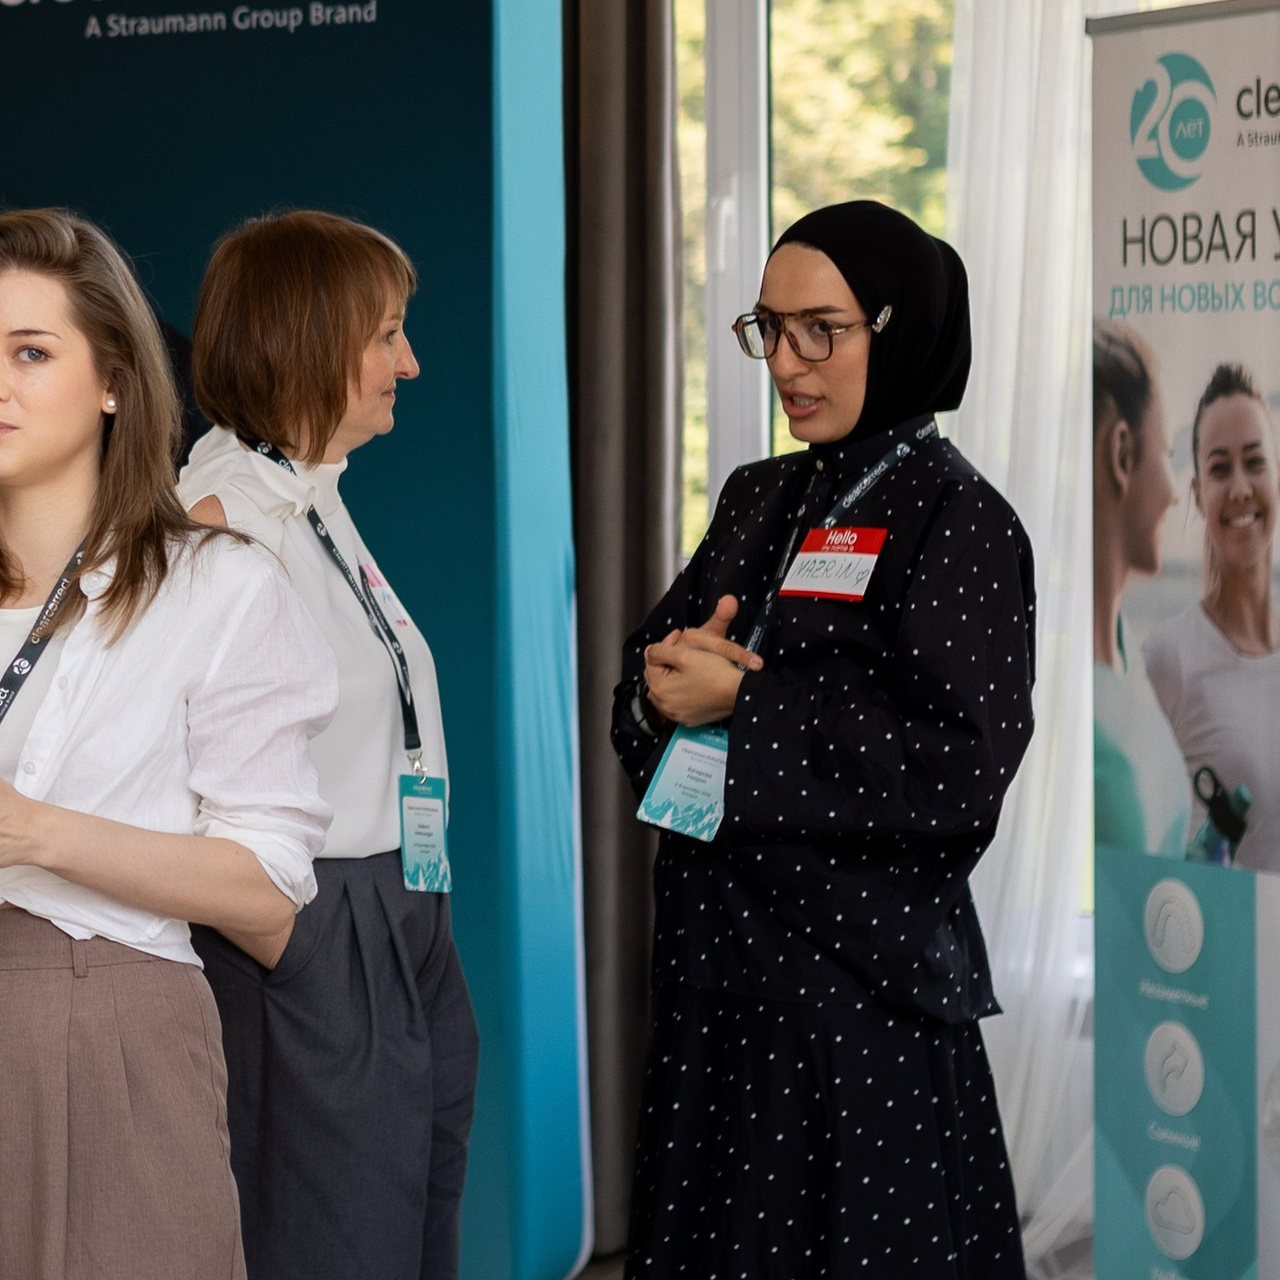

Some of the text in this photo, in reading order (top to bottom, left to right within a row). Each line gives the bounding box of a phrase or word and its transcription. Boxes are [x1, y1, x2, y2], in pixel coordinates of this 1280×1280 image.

[84, 17, 102, 39] A
[106, 8, 227, 39] Straumann
[232, 4, 303, 33] Group
[1122, 208, 1256, 268] НОВАЯ
[1108, 284, 1153, 320] ДЛЯ
[1160, 278, 1246, 314] НОВЫХ
[825, 529, 858, 545] Hello
